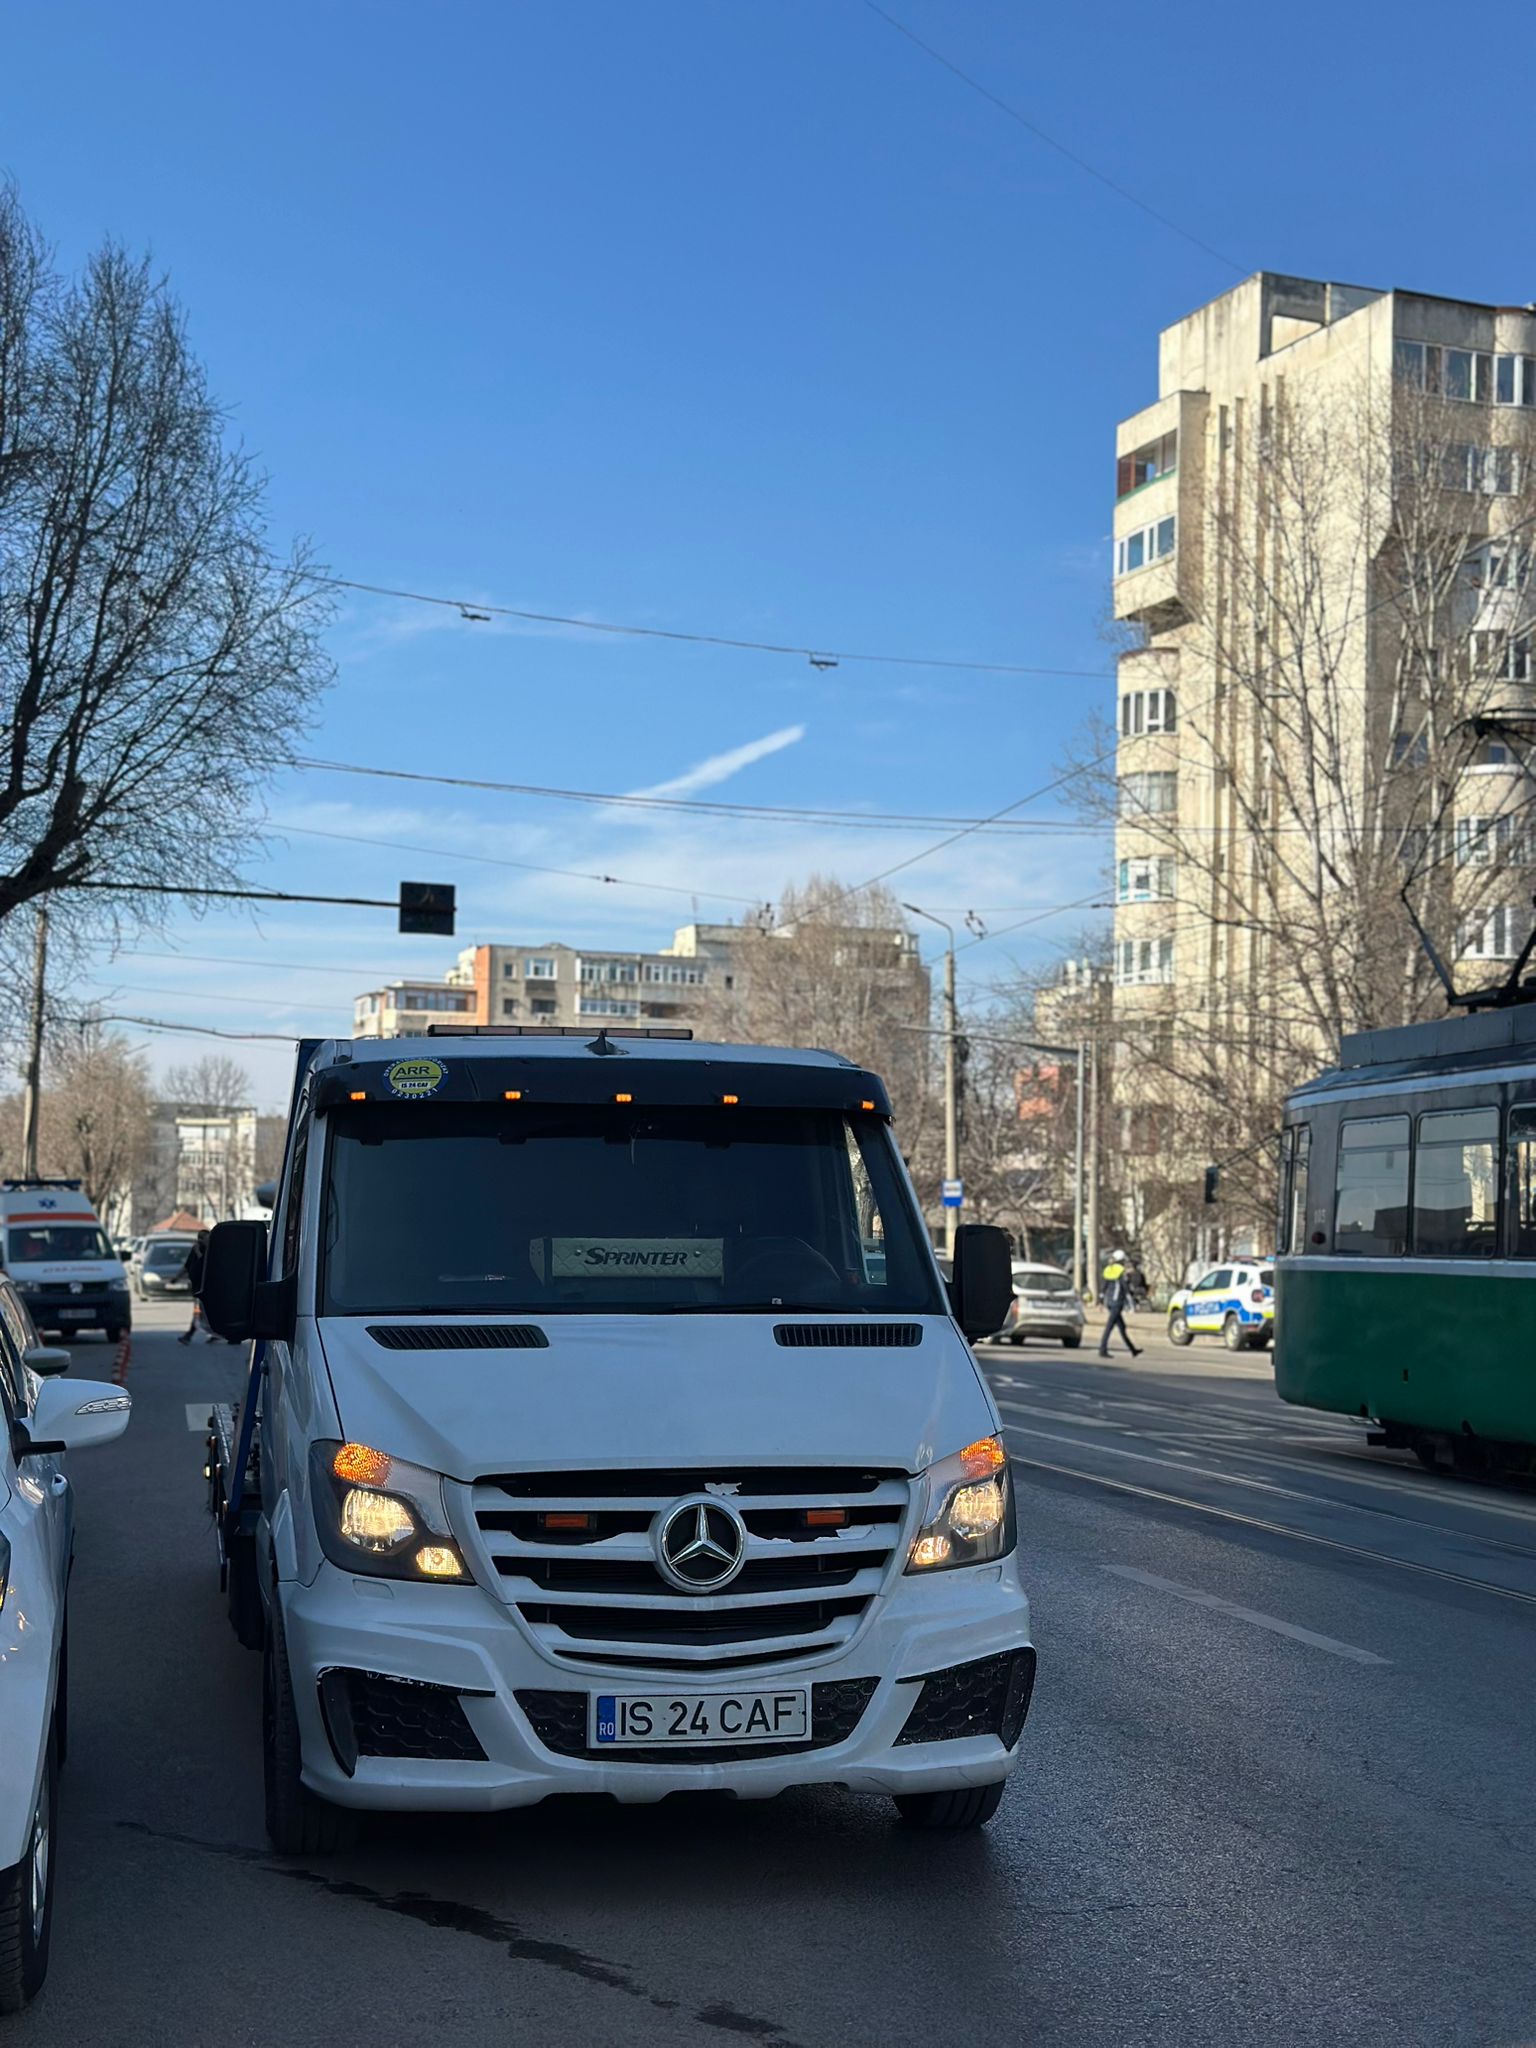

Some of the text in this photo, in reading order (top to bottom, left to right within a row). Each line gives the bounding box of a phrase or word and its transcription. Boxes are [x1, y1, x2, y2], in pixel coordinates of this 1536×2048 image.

[394, 1066, 430, 1076] ARR
[584, 1247, 688, 1266] SPRINTER
[599, 1696, 797, 1736] RO IS 24 CAF
